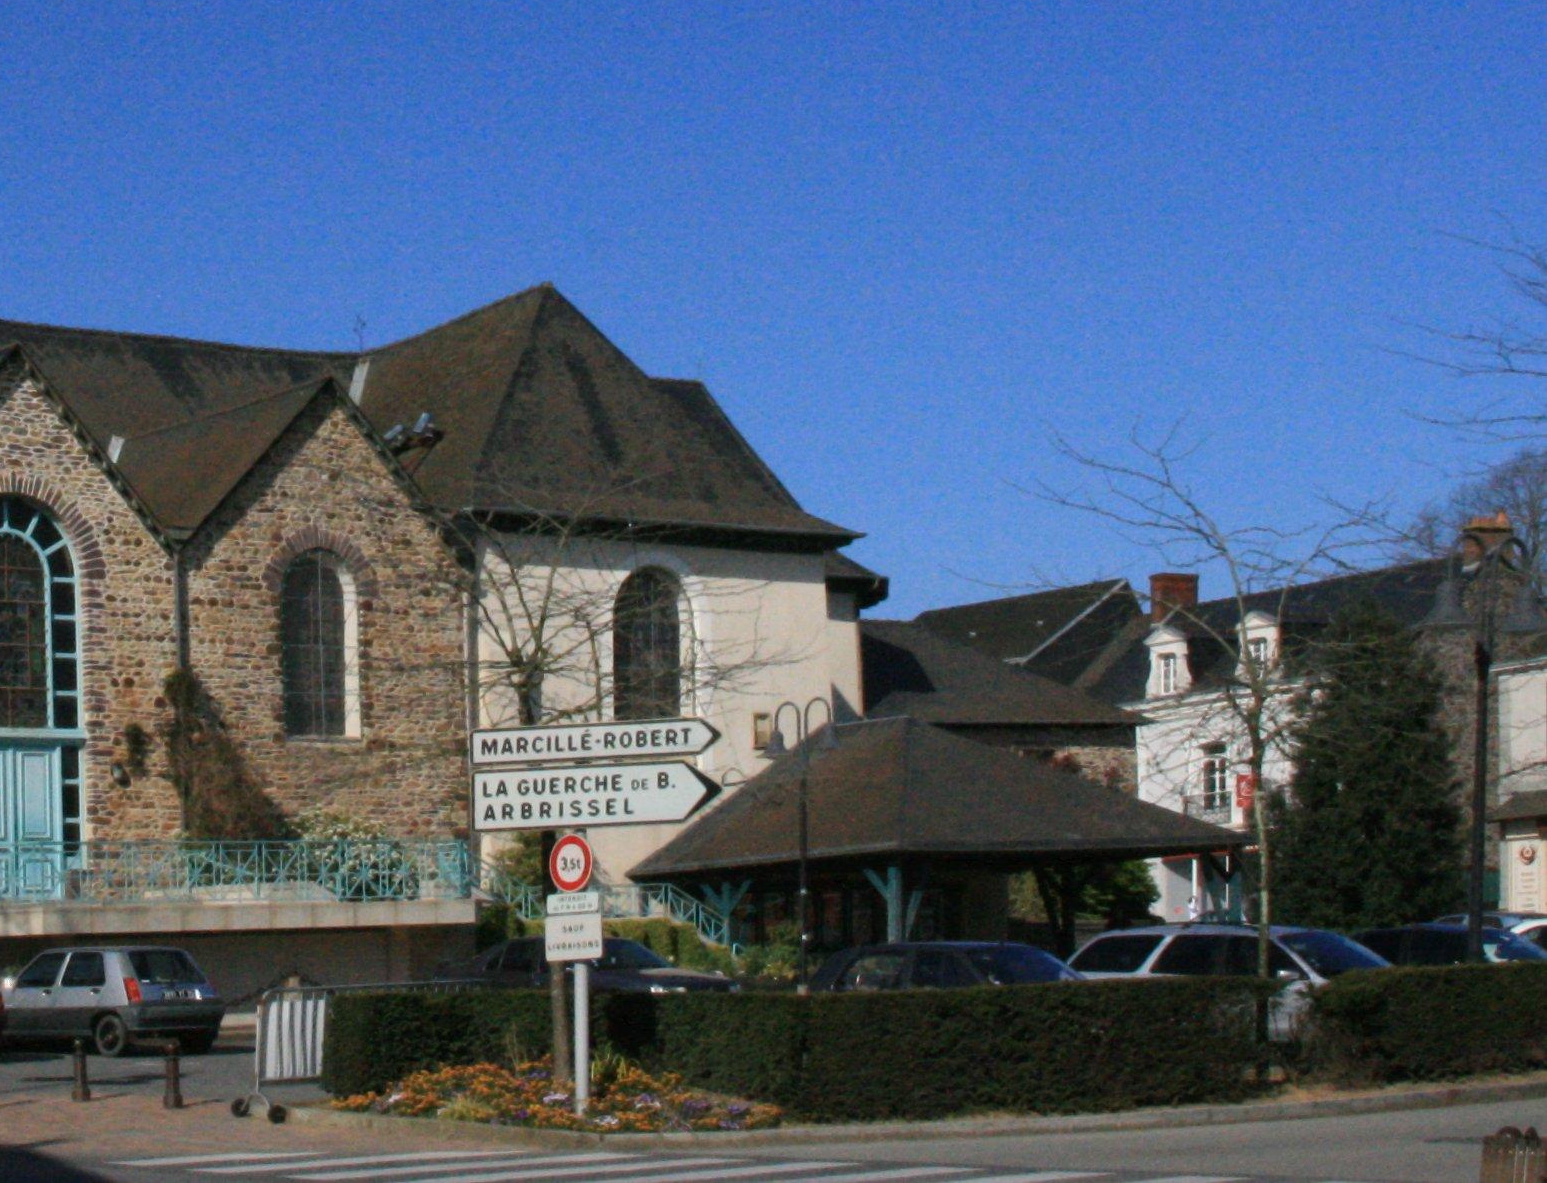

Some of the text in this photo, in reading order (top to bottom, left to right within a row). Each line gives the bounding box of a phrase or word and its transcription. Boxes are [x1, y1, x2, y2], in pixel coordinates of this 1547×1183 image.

[480, 727, 692, 756] MARCILLÉ-ROBERT
[482, 771, 676, 798] LA GUERCHE DE B.
[483, 798, 635, 822] ARBRISSEL
[562, 923, 584, 933] SAUF
[547, 939, 600, 951] LIVRAISONS
